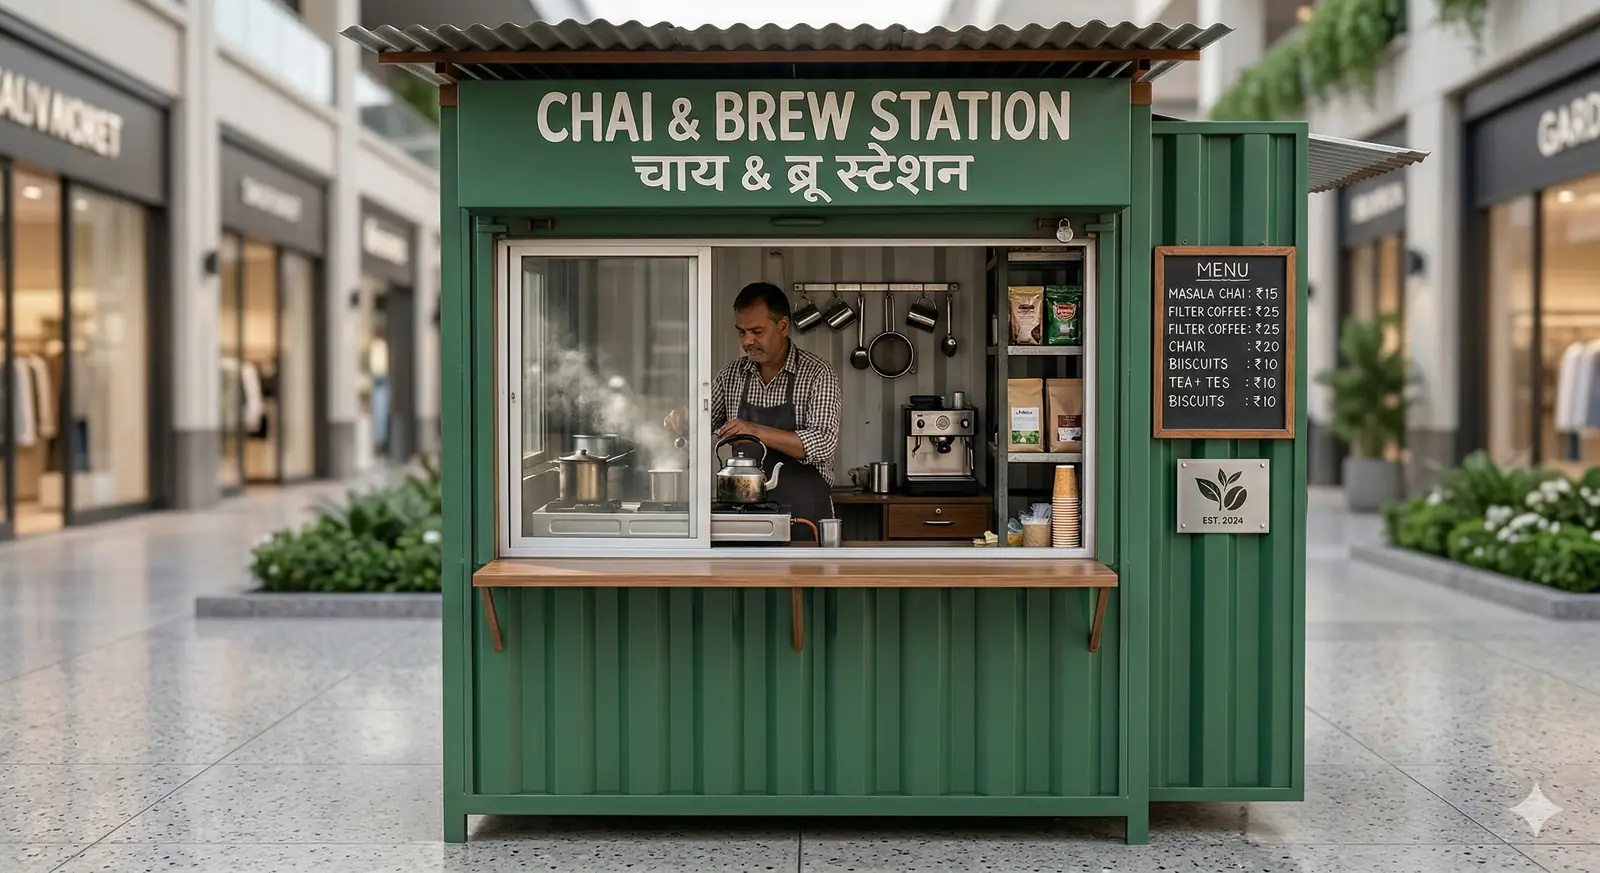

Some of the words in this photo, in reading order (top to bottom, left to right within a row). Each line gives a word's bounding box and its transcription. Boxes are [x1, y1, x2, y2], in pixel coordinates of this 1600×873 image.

[537, 91, 653, 143] CHAI
[668, 96, 701, 142] &
[715, 90, 855, 142] BREW
[868, 89, 1071, 142] STATION
[631, 155, 731, 192] चाय
[742, 155, 772, 191] &
[784, 155, 833, 203] ब्रू
[835, 142, 975, 196] स्टेशन
[1197, 262, 1249, 278] MENU
[1168, 287, 1215, 300] MASALA
[1255, 287, 1278, 300] ₹15
[1168, 306, 1205, 317] FILTER
[1255, 305, 1280, 317] ₹25
[1168, 323, 1205, 335] FILTER
[1255, 322, 1280, 335] ₹25
[1168, 340, 1206, 353] CHAIR
[1255, 340, 1280, 352] ₹20
[1168, 358, 1229, 370] BIISCUITS
[1205, 376, 1230, 389] TES
[1253, 376, 1277, 389] ₹10
[1168, 394, 1225, 408] BISCUITS
[1253, 395, 1277, 408] ₹10
[1202, 516, 1221, 525] EST.
[1222, 516, 1244, 525] 2024
